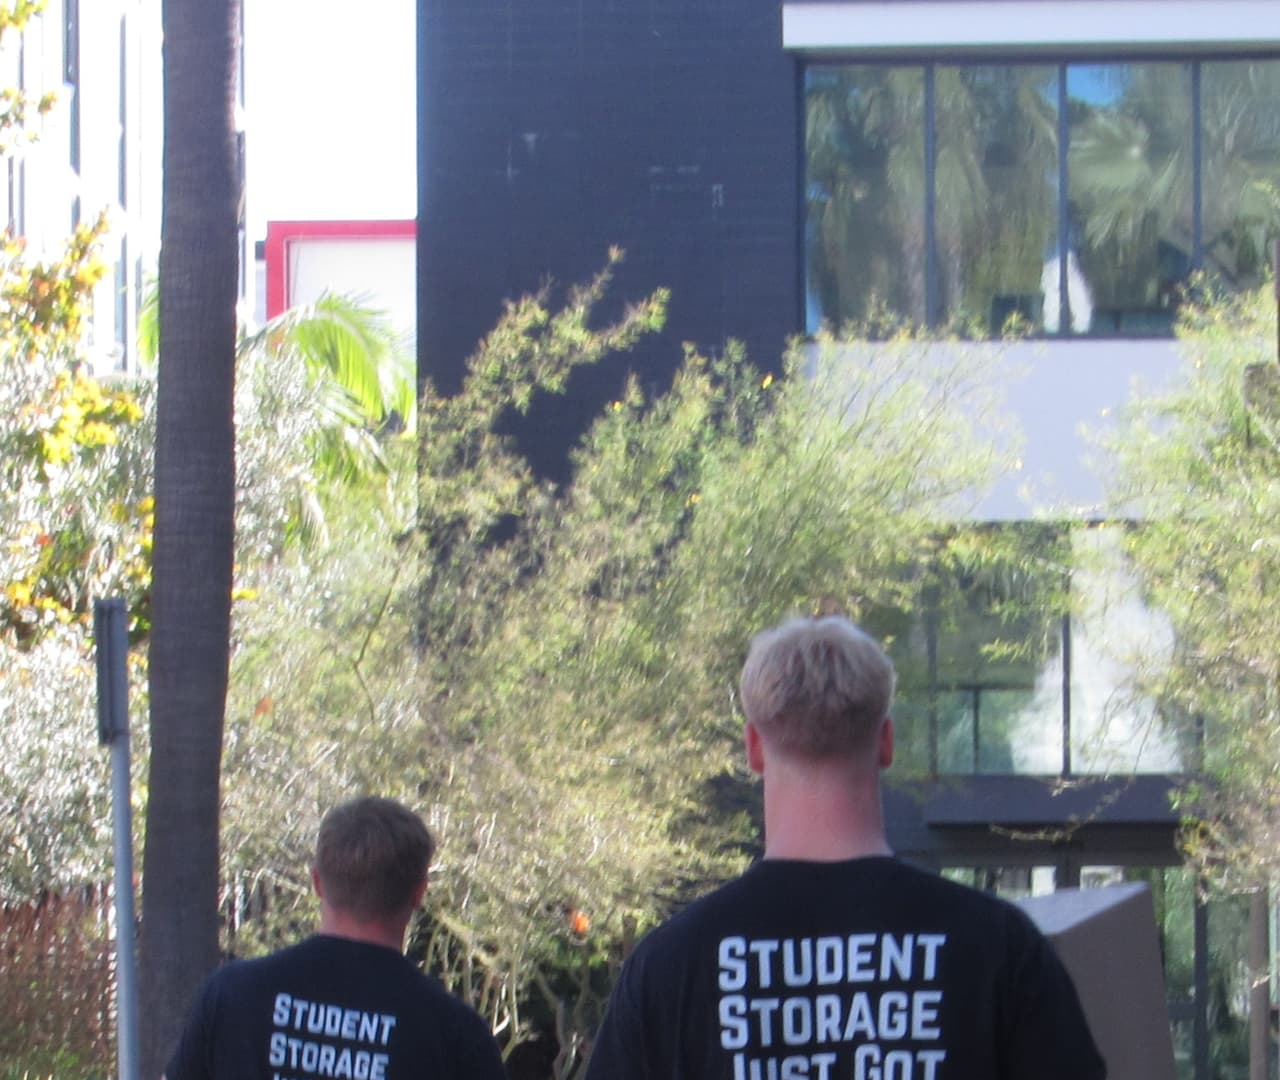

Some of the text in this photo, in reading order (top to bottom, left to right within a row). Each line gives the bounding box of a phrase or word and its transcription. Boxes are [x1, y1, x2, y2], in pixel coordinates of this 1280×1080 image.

[718, 933, 946, 991] STUDENT
[273, 992, 396, 1047] STUDENT
[719, 990, 943, 1050] STORAGE
